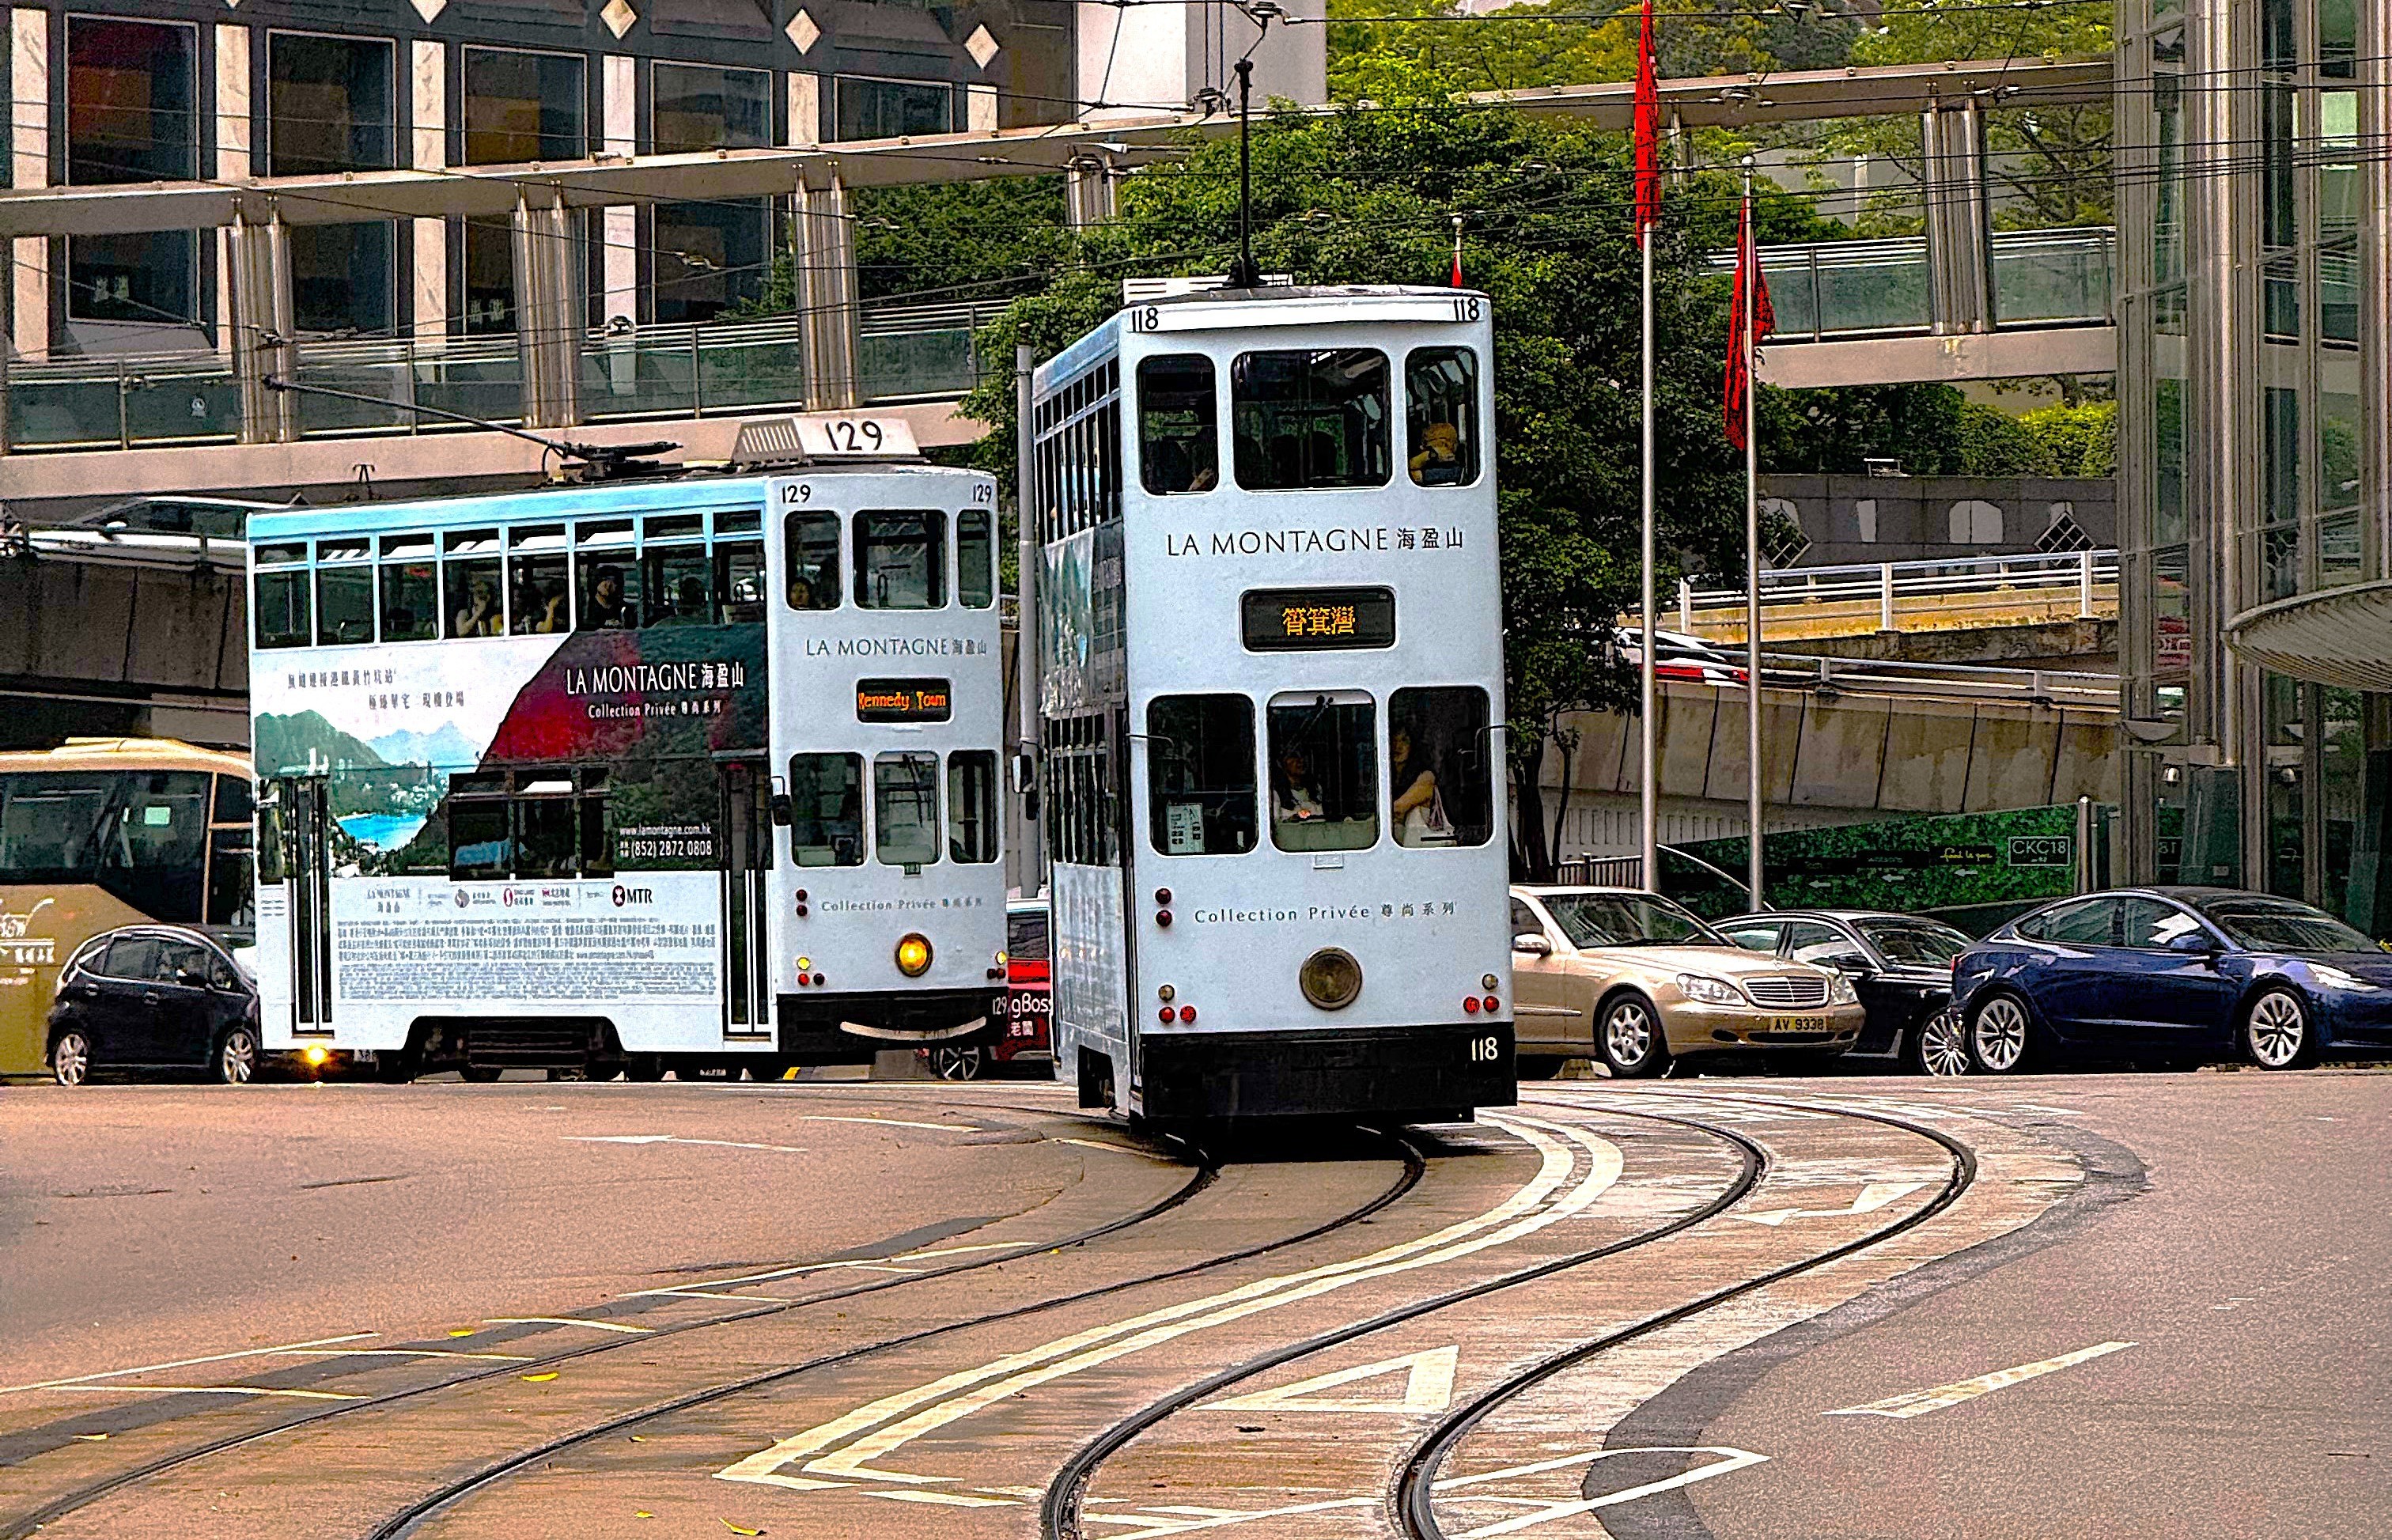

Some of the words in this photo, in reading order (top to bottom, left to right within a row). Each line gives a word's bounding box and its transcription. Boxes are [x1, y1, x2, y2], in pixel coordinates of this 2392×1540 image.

[1453, 297, 1479, 322] 118
[1132, 307, 1158, 332] 118
[825, 420, 883, 451] 129
[782, 484, 811, 504] 129
[973, 484, 992, 502] 129
[1168, 533, 1200, 556] LA
[1212, 528, 1387, 554] MONTAGNE
[1397, 526, 1463, 550] 海盈山
[806, 638, 830, 656] LA
[838, 638, 948, 656] MONTAGNE
[566, 668, 587, 694] LA
[593, 663, 697, 694] MONTAGNE
[702, 661, 744, 688] 海盈山
[589, 703, 641, 718] Collection
[644, 702, 676, 716] Privée
[858, 692, 909, 710] Kennedy
[916, 691, 946, 709] Town
[631, 840, 657, 858] (852)
[659, 840, 684, 856] 2872
[687, 840, 712, 856] 0808
[2012, 840, 2067, 854] CKC18
[626, 888, 653, 904] MTR
[821, 899, 892, 911] Collection
[898, 899, 937, 910] Privée
[1194, 906, 1297, 924] Collection
[1308, 905, 1370, 921] Privée
[992, 996, 1008, 1015] 129
[1774, 1018, 1789, 1030] AV
[1471, 1036, 1498, 1061] 118
